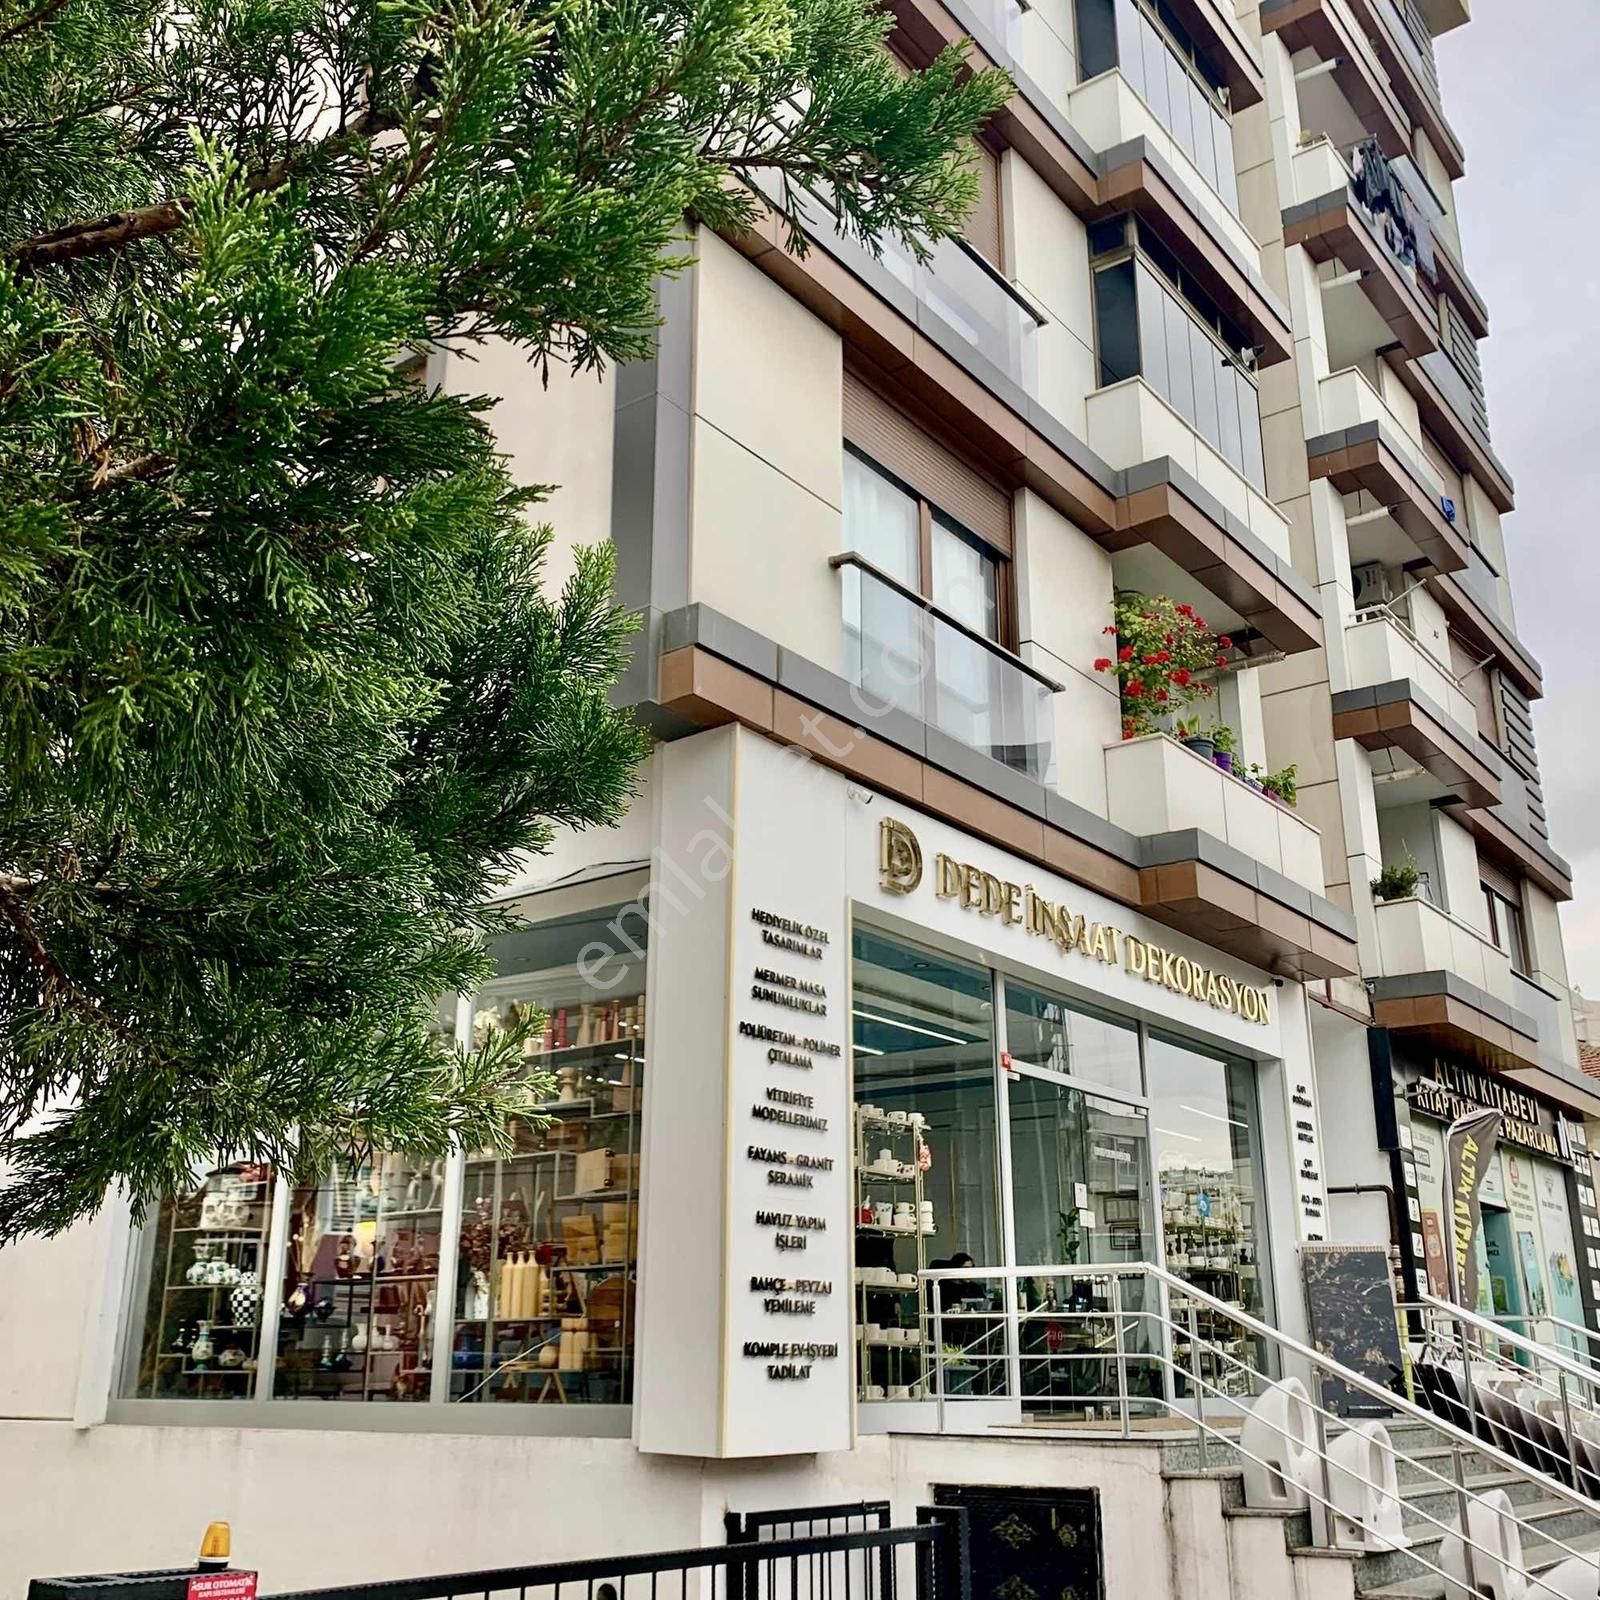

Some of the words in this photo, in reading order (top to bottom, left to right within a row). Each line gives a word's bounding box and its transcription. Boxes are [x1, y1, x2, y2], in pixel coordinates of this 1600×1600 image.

[805, 925, 830, 945] ÖZEL
[935, 851, 1022, 926] DEDE
[1025, 881, 1122, 965] İNŞAAT
[1124, 935, 1272, 1026] DEKORASYON
[754, 966, 797, 990] MERMER
[799, 978, 828, 998] MASA
[1504, 1118, 1560, 1157] PAZARLAMA
[747, 1145, 787, 1164] FAYANS
[767, 1170, 814, 1188] SERAMİK
[756, 1211, 793, 1227] HAVUZ
[795, 1214, 827, 1231] YAPIM
[750, 1276, 787, 1296] BAHÇE
[795, 1279, 832, 1295] PEYZAJ
[763, 1297, 816, 1315] YENİLEME
[743, 1341, 789, 1357] KOMPLE
[767, 1362, 812, 1379] TADİLAT
